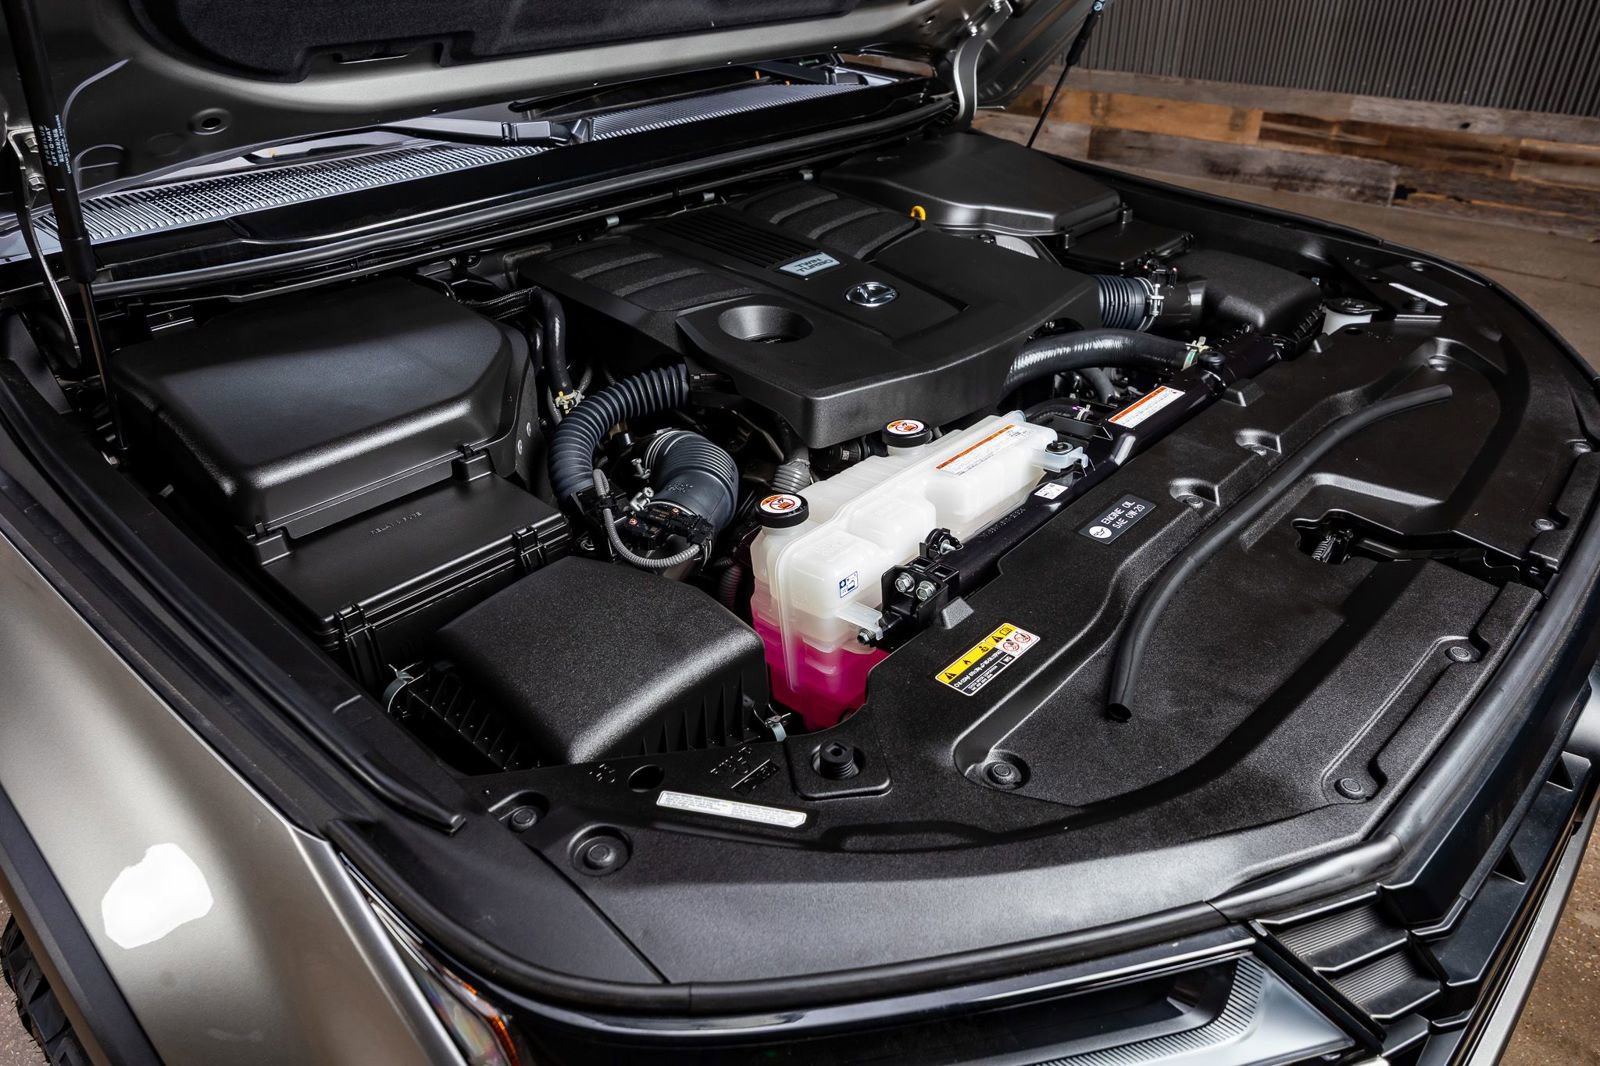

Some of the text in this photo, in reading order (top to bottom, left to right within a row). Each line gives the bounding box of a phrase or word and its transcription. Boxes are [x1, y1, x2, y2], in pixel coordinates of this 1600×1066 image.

[794, 257, 822, 268] TWIN
[796, 259, 834, 273] TURBO
[1100, 500, 1136, 525] ENGINE OIL
[1112, 517, 1129, 529] SAE
